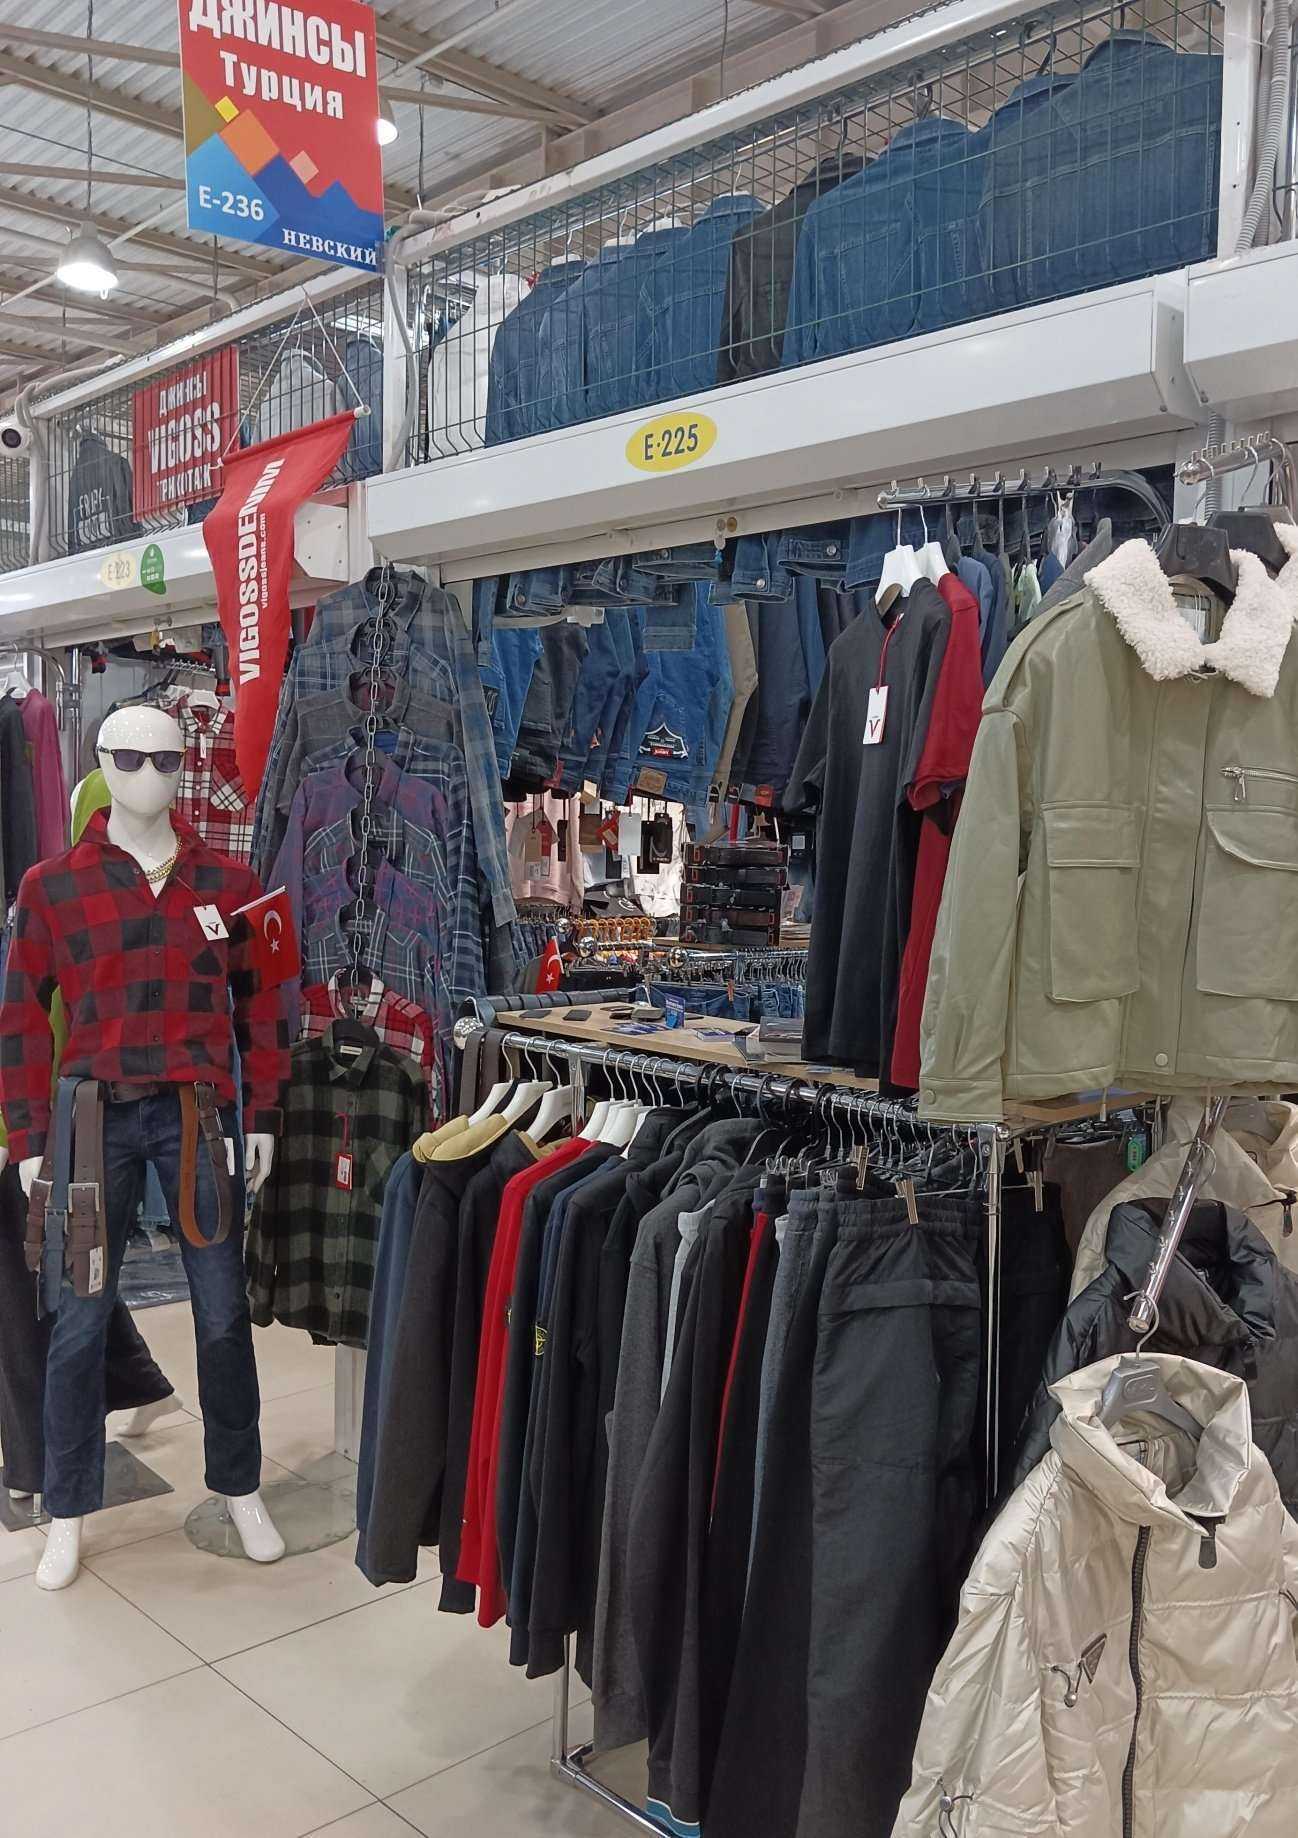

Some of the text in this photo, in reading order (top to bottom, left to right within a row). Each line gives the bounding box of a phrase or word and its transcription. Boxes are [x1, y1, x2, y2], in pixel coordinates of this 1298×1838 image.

[188, 0, 367, 78] ДЖИНСЫ
[219, 50, 344, 120] Турция
[198, 185, 265, 222] E-236
[281, 228, 378, 266] НЕВСКИЙ
[148, 402, 221, 474] VIGOSS
